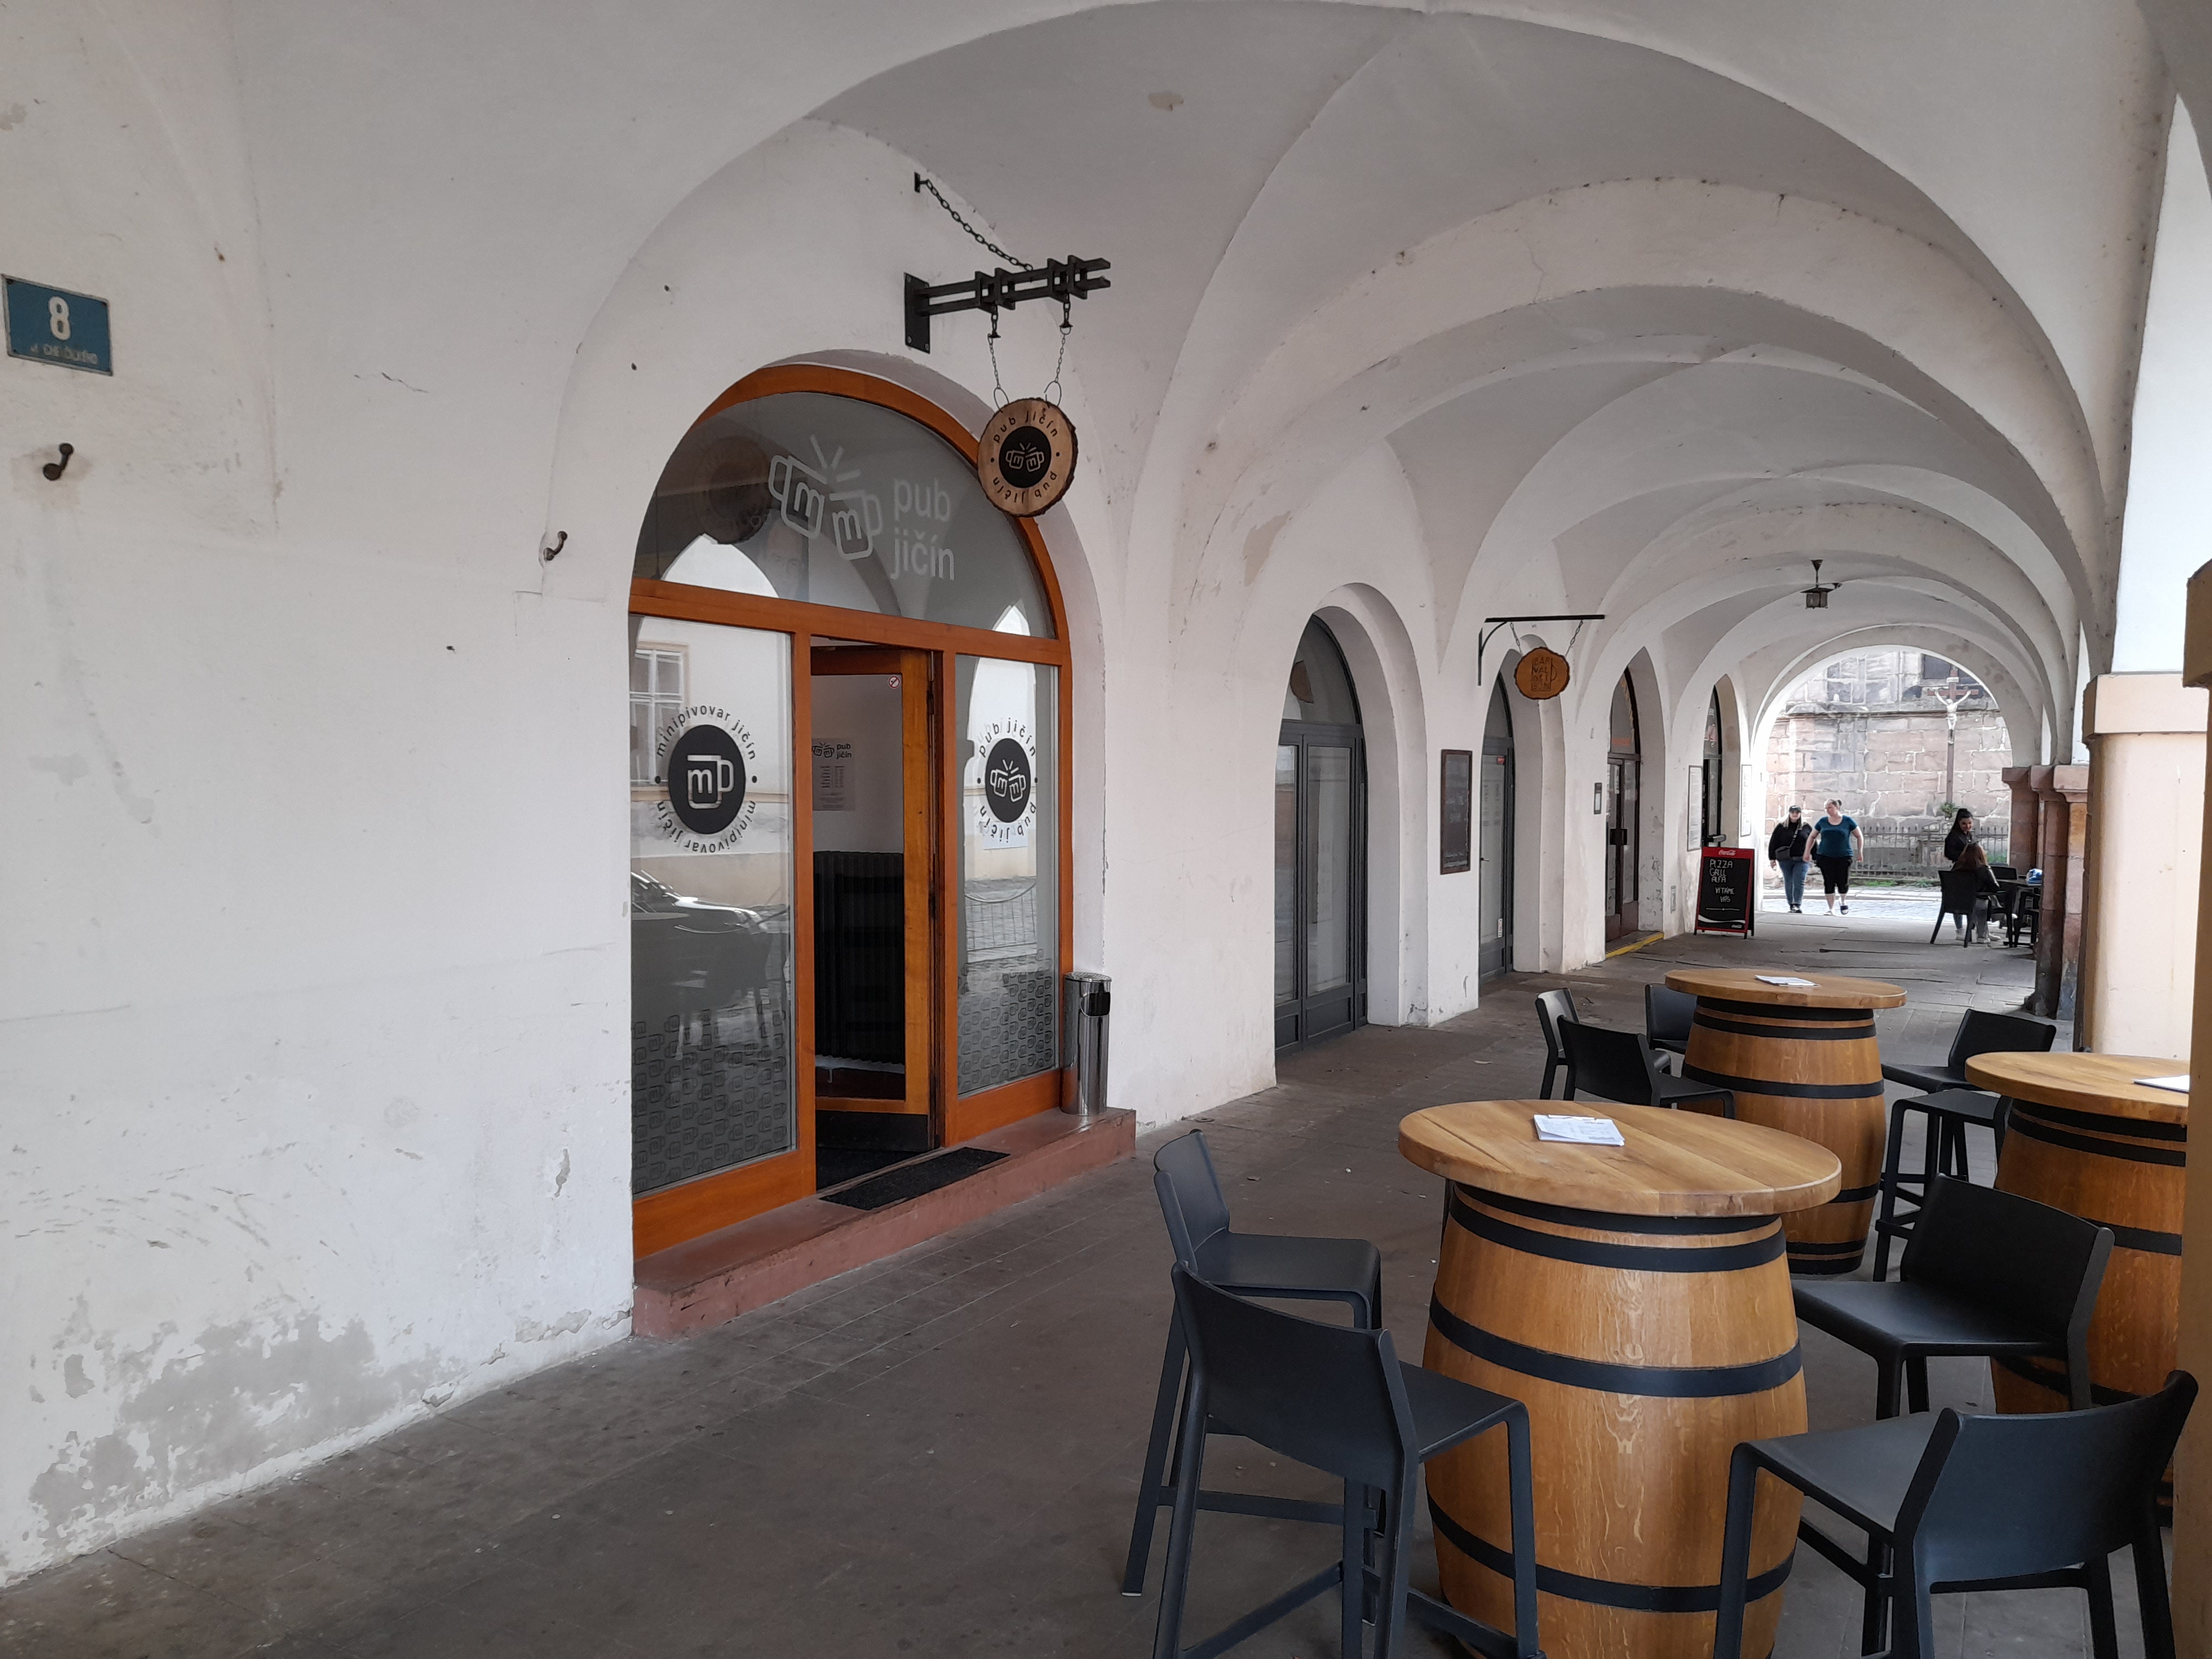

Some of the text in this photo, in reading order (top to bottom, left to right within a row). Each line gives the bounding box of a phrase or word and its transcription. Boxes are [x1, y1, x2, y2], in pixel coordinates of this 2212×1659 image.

[48, 296, 71, 341] 8
[994, 417, 1016, 443] pub
[894, 477, 951, 522] pub
[1034, 471, 1057, 498] pub
[890, 527, 955, 580] jičín
[656, 705, 756, 760] minipivovar jičín
[979, 717, 1036, 758] pub jičín
[836, 751, 852, 759] jičín
[657, 800, 756, 853] minipivovar jičín
[980, 802, 1036, 843] pub jičín
[1709, 859, 1733, 868] PIZZA
